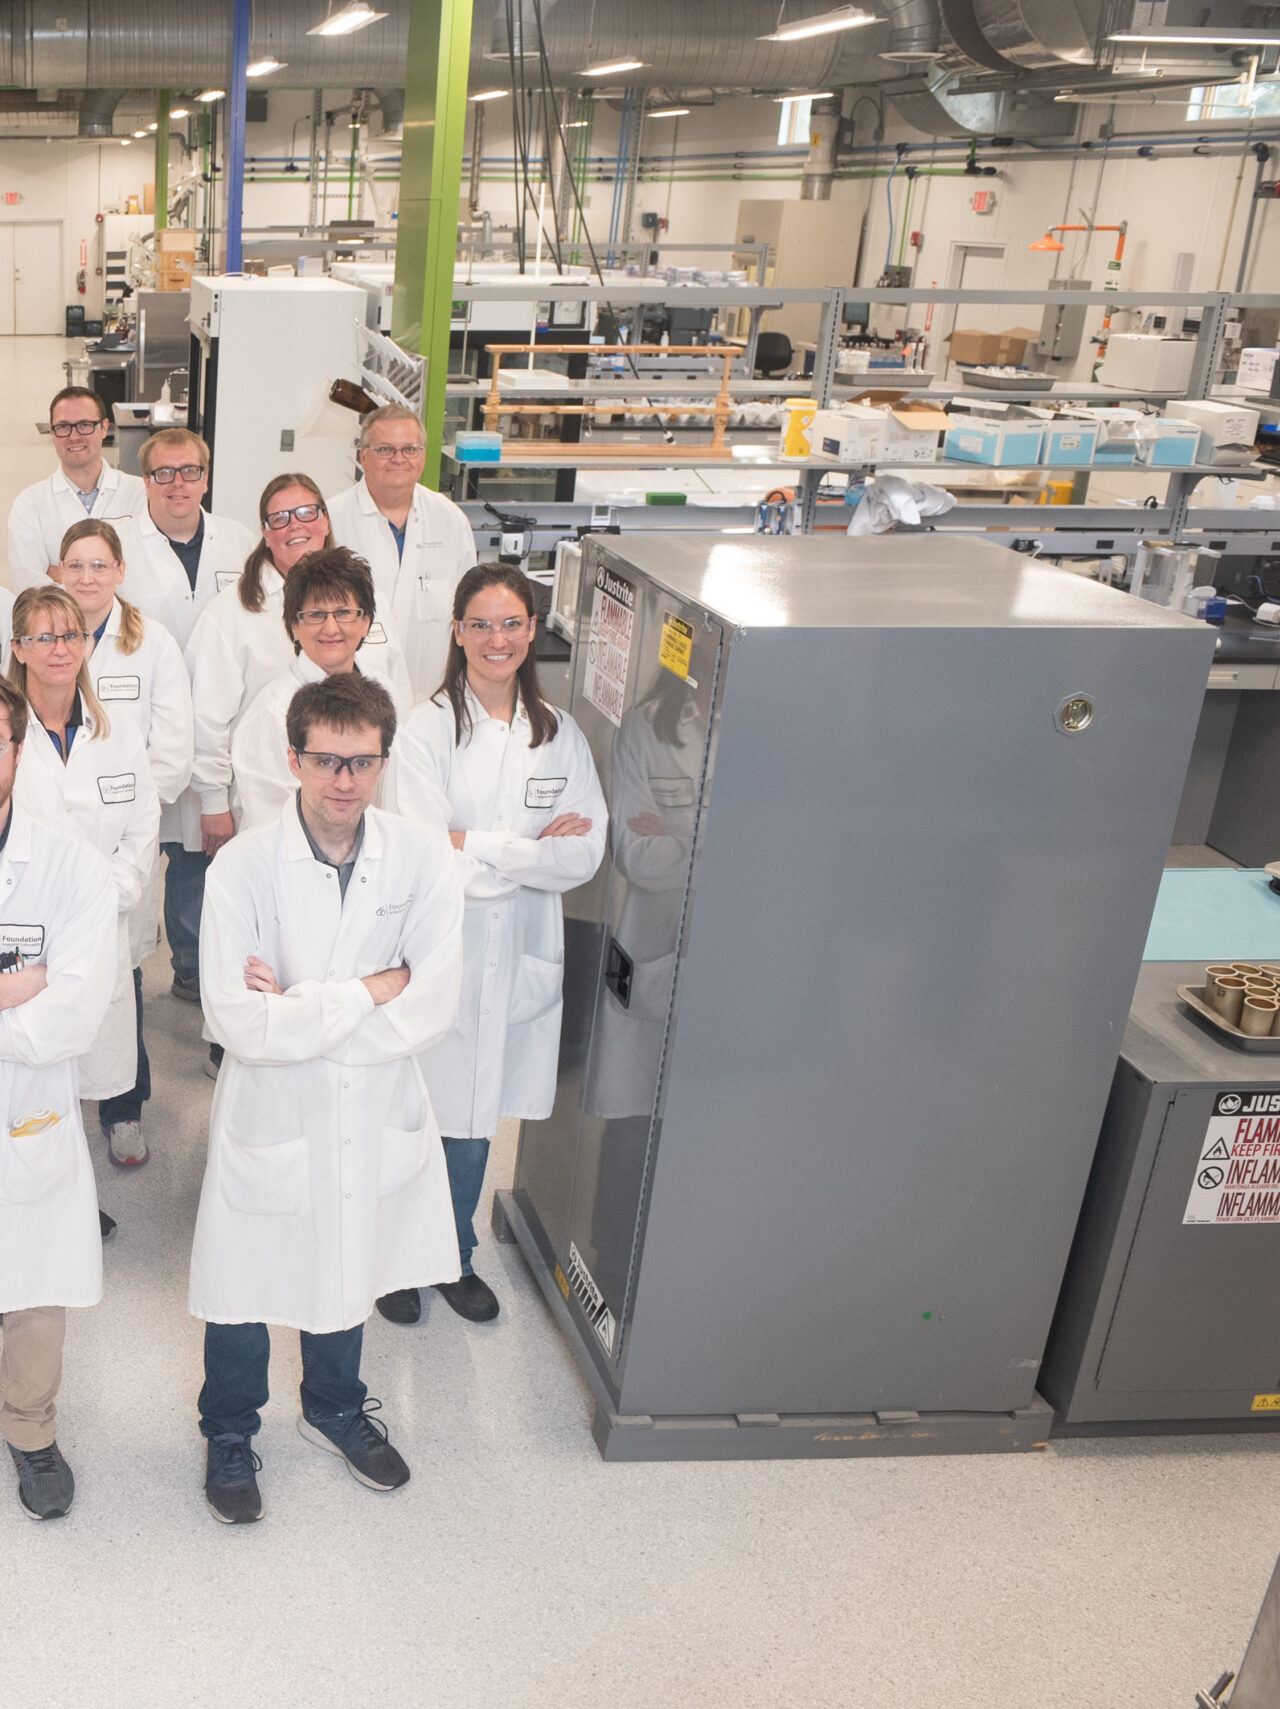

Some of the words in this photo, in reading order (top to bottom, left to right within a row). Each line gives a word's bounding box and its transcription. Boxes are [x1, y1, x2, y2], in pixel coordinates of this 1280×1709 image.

[604, 572, 634, 607] Justrite
[2, 935, 42, 943] Foundation
[1233, 1117, 1280, 1143] FLAM
[1230, 1143, 1261, 1156] KEEP
